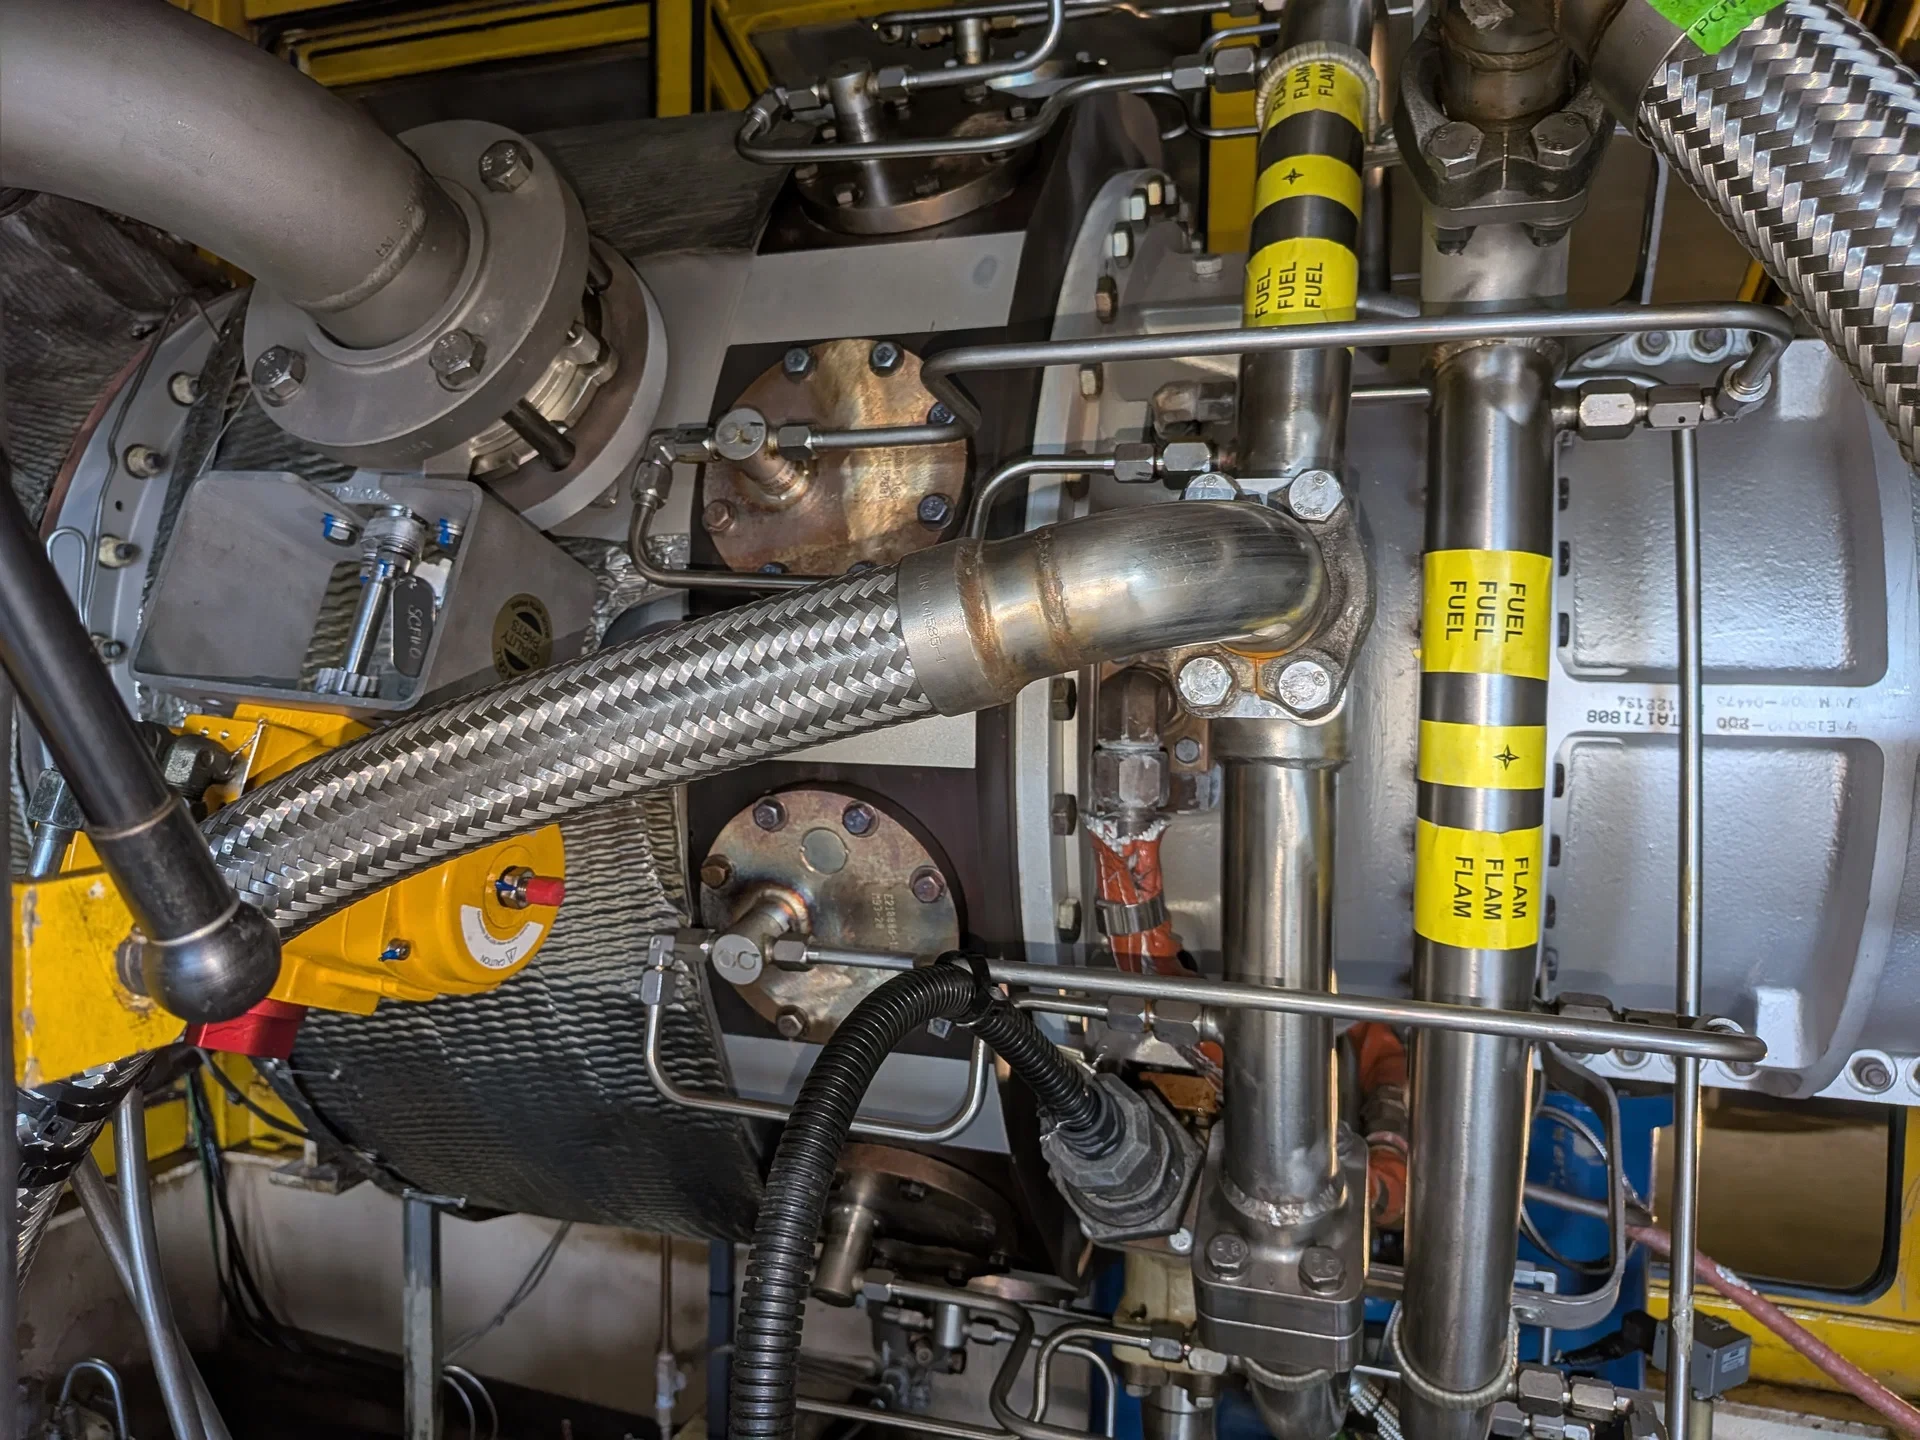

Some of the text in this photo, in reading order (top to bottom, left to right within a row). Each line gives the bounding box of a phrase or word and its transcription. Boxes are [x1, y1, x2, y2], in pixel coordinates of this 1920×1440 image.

[1294, 65, 1312, 99] FLAM
[1318, 64, 1335, 97] FLAM
[1255, 268, 1271, 319] FUEL
[1277, 262, 1297, 309] FUEL
[1304, 262, 1323, 309] FUEL
[512, 619, 540, 649] PARTS
[1446, 581, 1467, 641] FUEL
[1474, 581, 1497, 641] FUEL
[1505, 583, 1526, 643] FUEL
[501, 630, 540, 665] QUALITY
[1587, 710, 1679, 727] TA171808
[1453, 856, 1473, 918] FLAM
[1483, 859, 1504, 920] FLAM
[1512, 857, 1529, 919] FLAM
